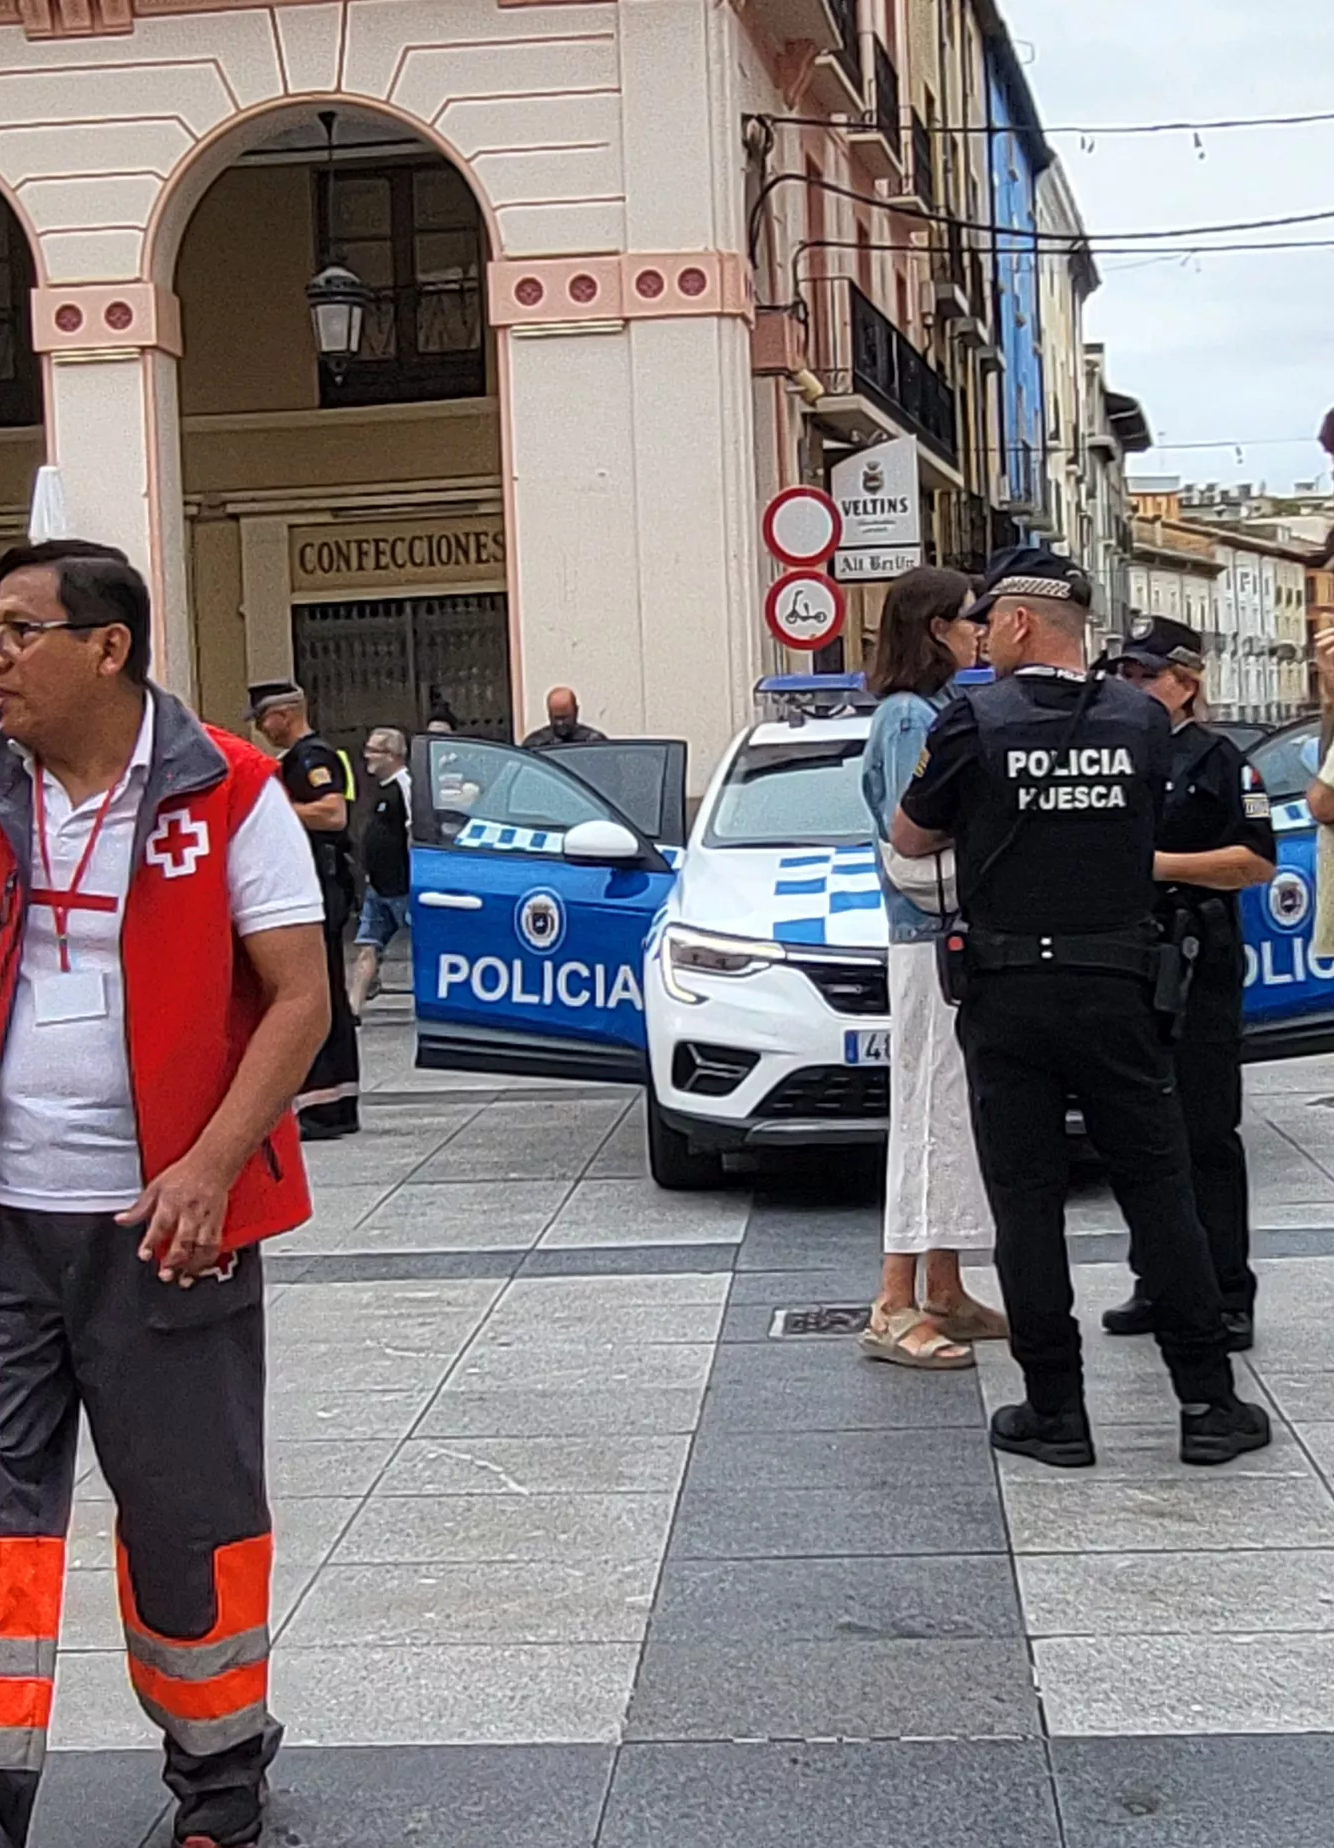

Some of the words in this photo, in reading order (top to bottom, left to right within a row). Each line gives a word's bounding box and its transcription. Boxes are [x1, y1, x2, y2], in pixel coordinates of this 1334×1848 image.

[841, 497, 908, 517] VELTINS
[299, 531, 505, 575] CONFECCIONES
[1007, 749, 1133, 778] POLICIA
[436, 953, 644, 1011] POLICIA
